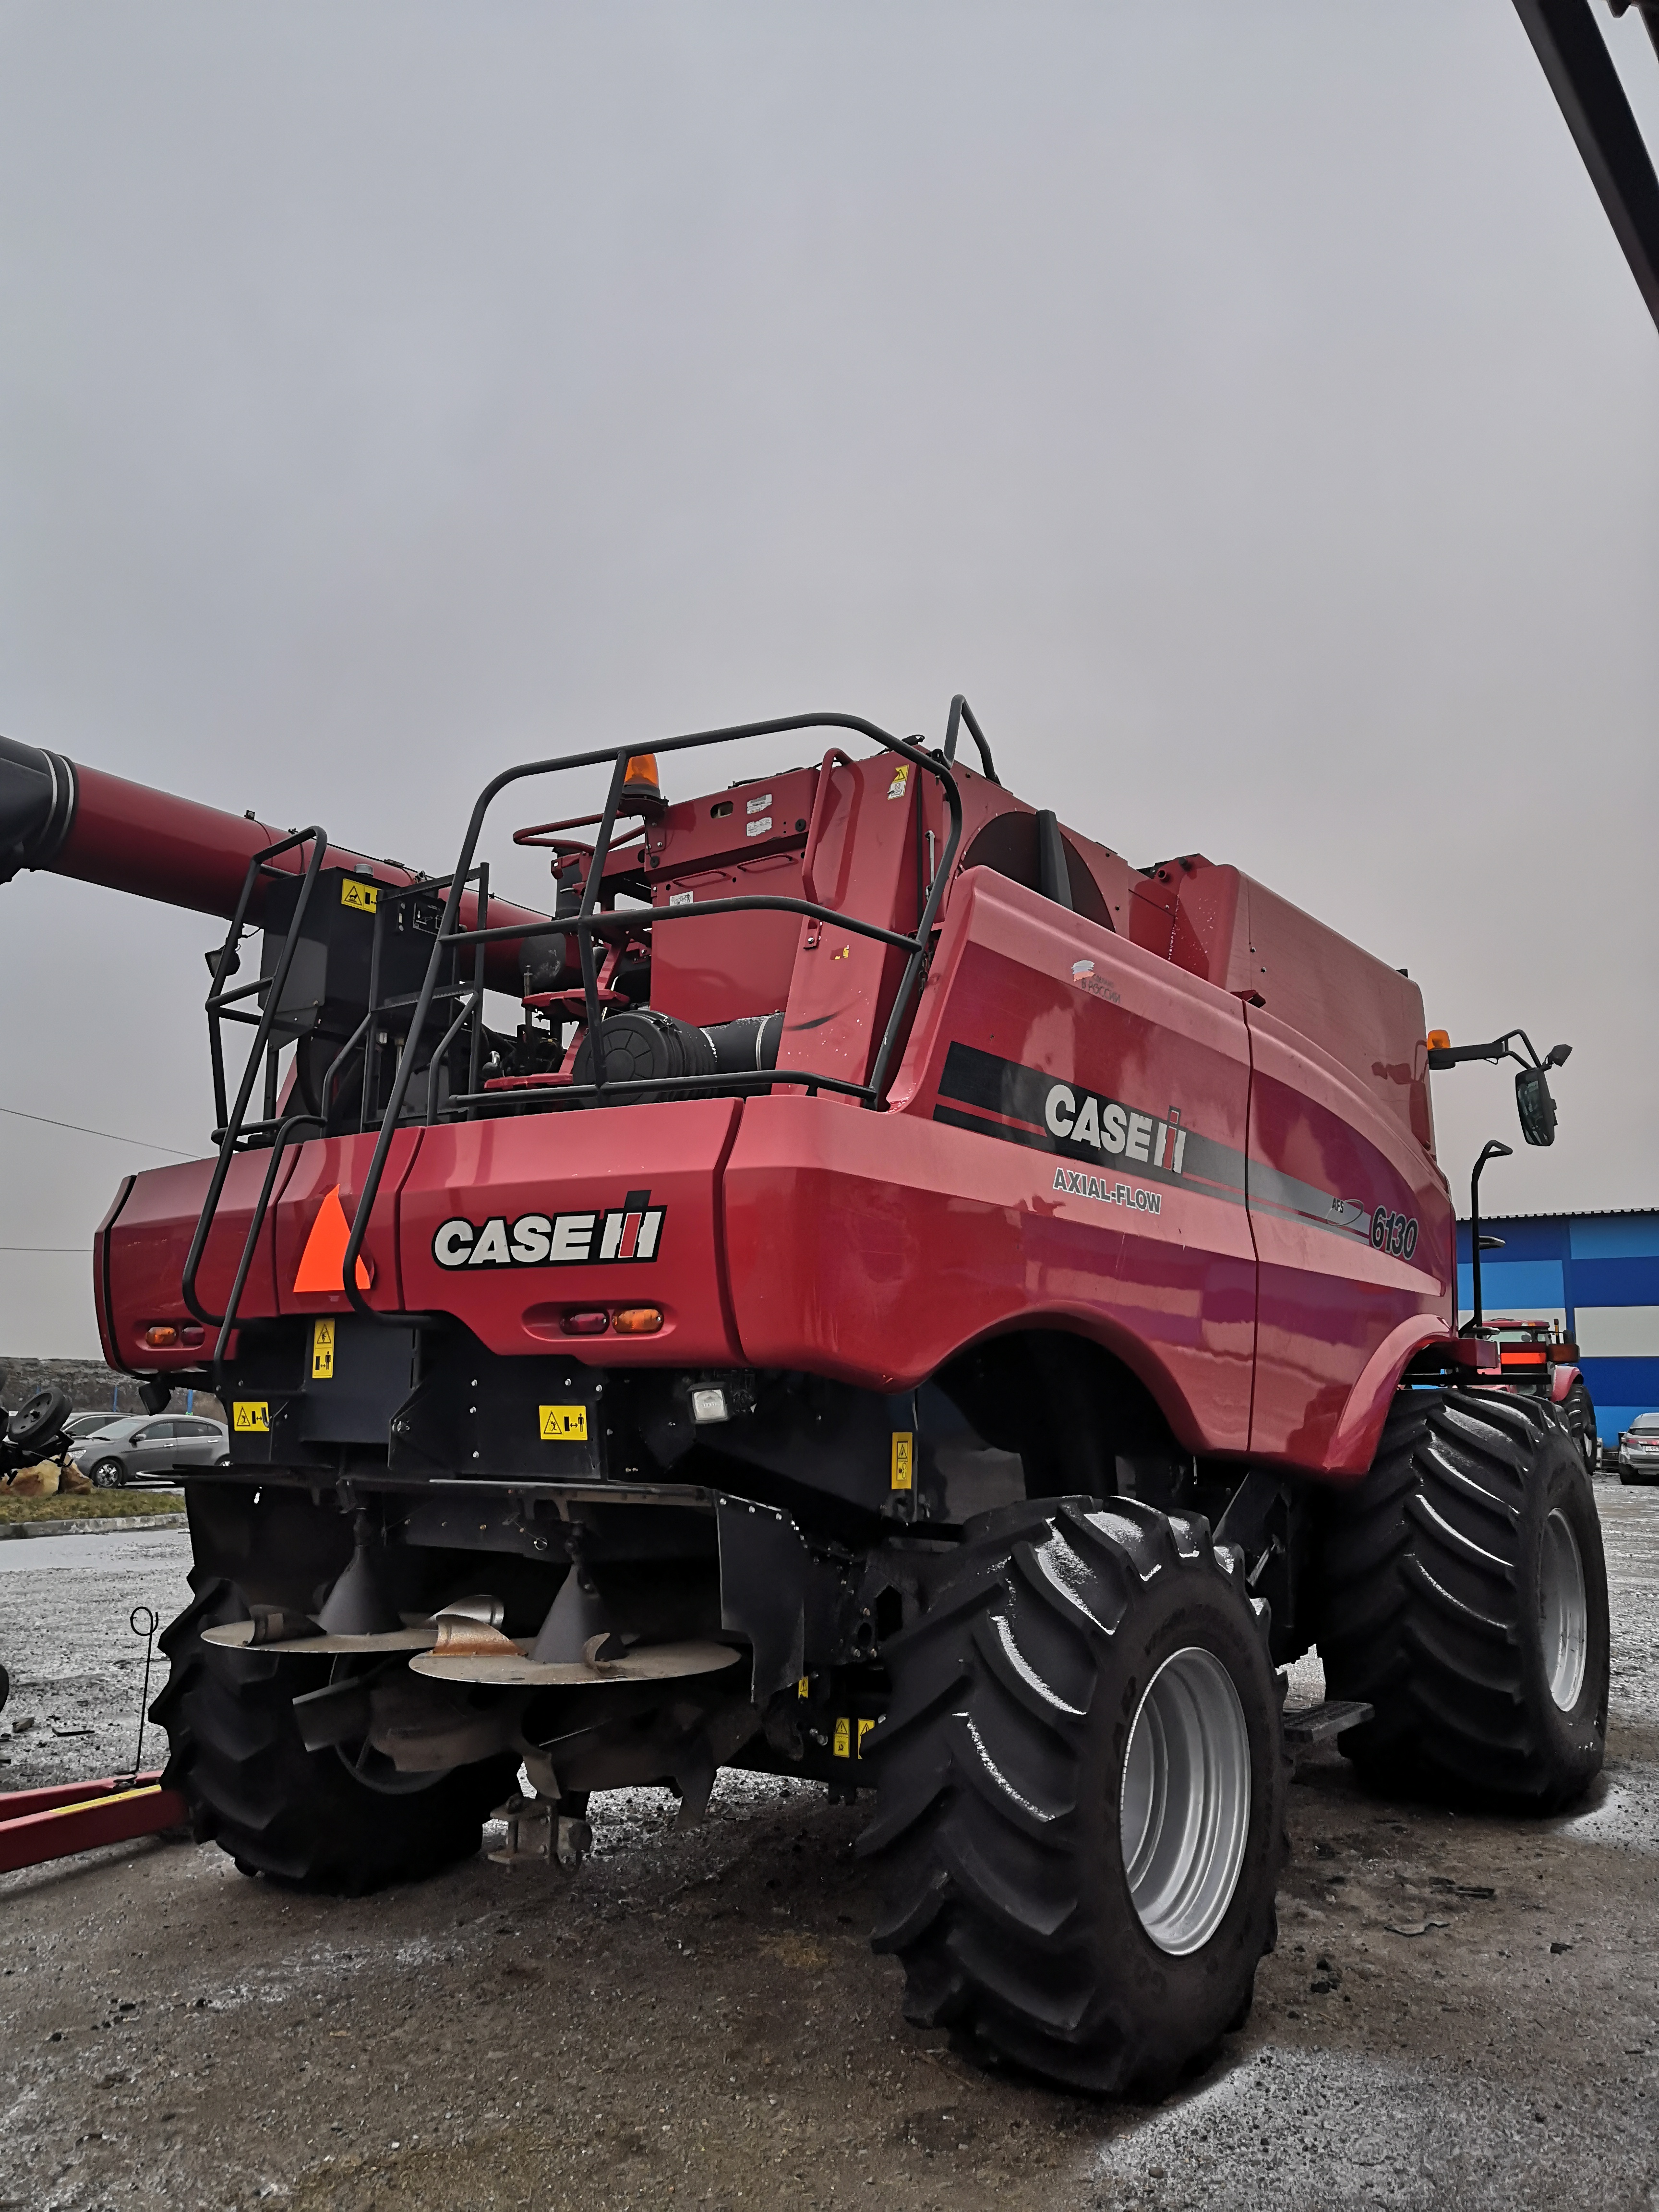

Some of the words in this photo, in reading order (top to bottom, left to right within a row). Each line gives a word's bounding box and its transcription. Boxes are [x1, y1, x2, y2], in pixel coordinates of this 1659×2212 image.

[1045, 1084, 1153, 1163] CASE
[1053, 1167, 1162, 1215] AXIAL-FLOW
[1332, 1197, 1344, 1213] AFS
[435, 1214, 595, 1266] CASE
[1371, 1205, 1419, 1261] 6130
